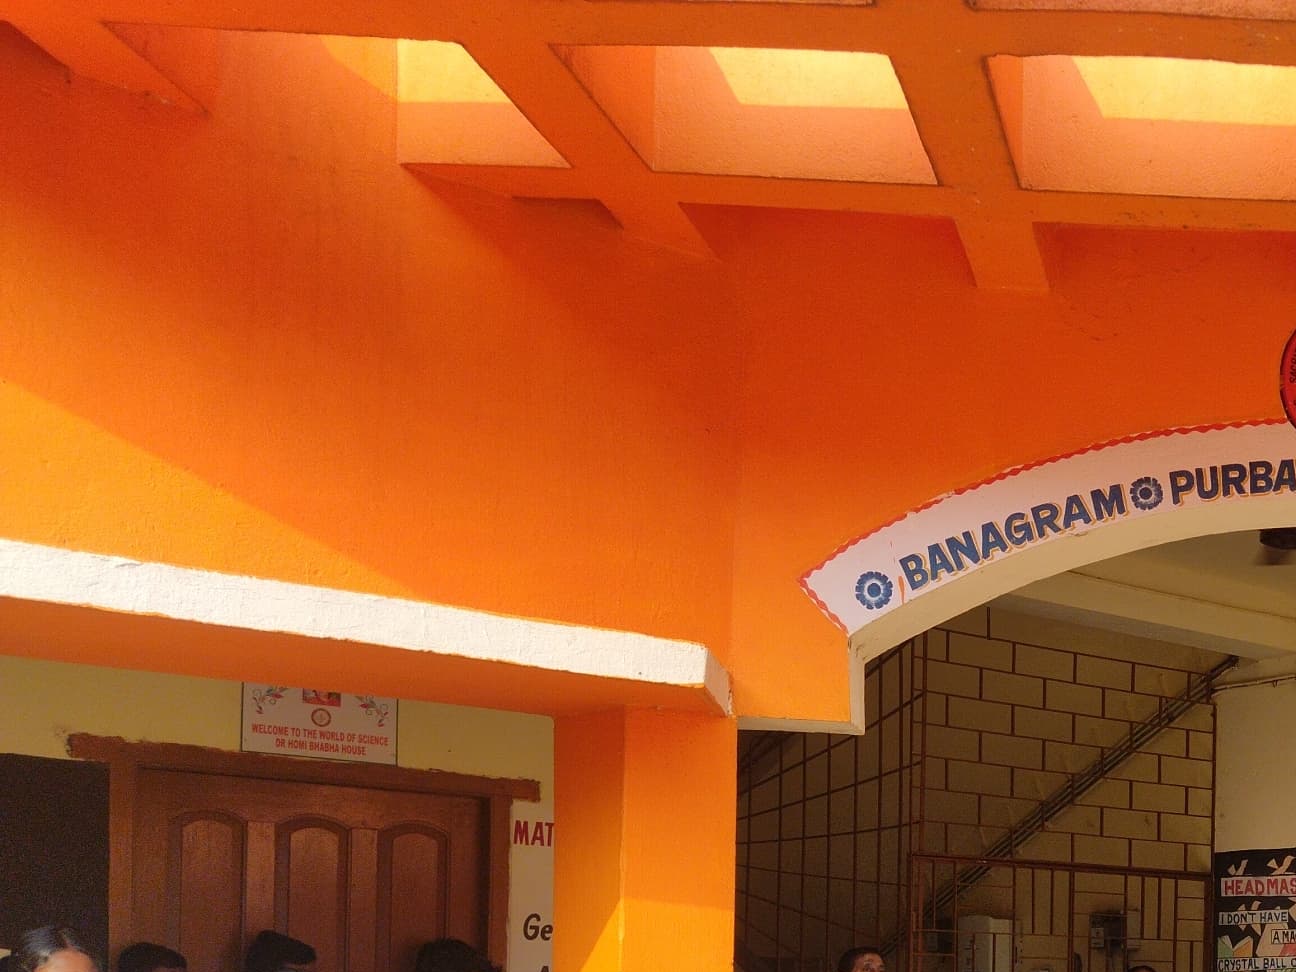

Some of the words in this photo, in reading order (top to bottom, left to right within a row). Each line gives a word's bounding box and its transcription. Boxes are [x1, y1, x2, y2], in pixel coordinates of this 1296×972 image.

[899, 484, 1128, 591] BANAGRAM
[251, 723, 289, 737] WELCOME
[292, 727, 300, 737] TO
[303, 728, 317, 739] THE
[319, 730, 345, 742] WORLD
[347, 732, 356, 743] OF
[358, 734, 389, 747] SCIENCE
[288, 739, 307, 750] HOMI
[309, 740, 339, 753] BHABHA
[341, 743, 367, 756] HOUSE
[1227, 911, 1256, 924] DON'T
[1260, 911, 1288, 922] HAVE
[1273, 930, 1280, 944] A
[1217, 958, 1259, 971] CRYSTAL
[1264, 957, 1286, 969] BALL
